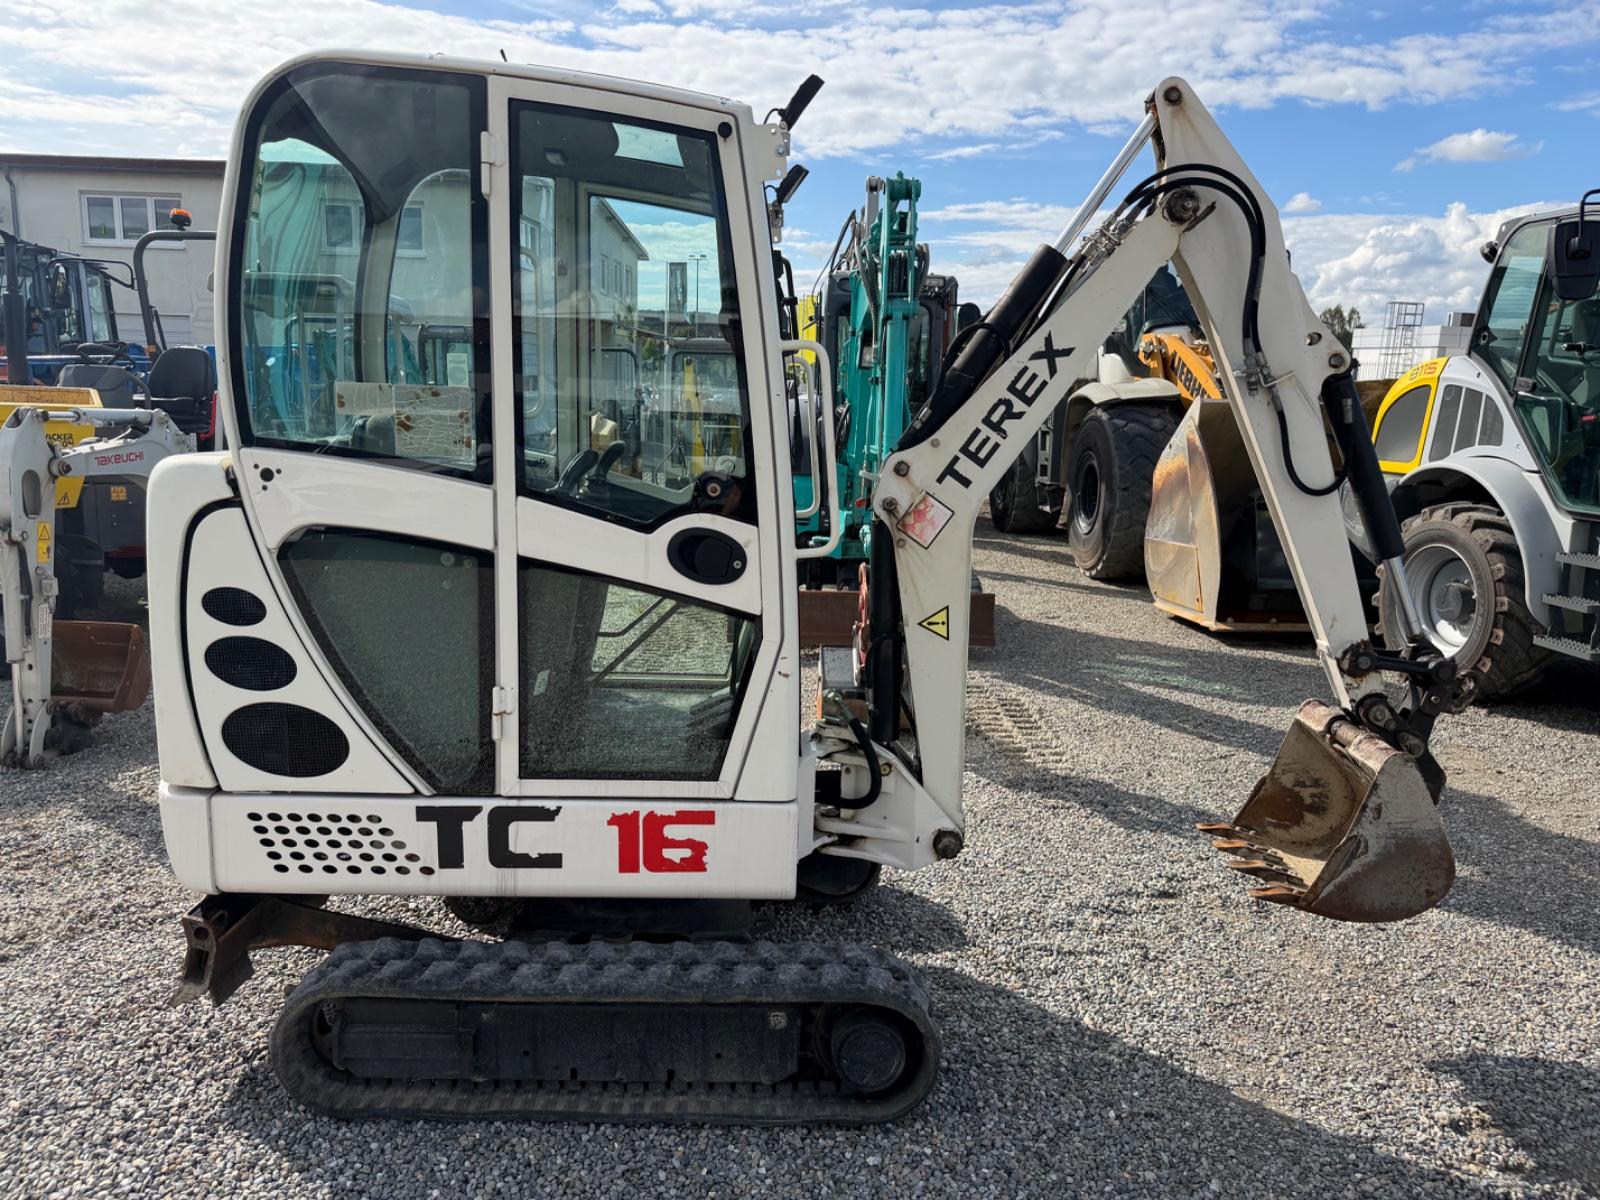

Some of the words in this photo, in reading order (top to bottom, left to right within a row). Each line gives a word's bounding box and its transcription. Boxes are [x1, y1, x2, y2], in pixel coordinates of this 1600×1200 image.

[936, 330, 1076, 489] TEREX
[415, 805, 563, 869] TC
[606, 810, 716, 873] 16
